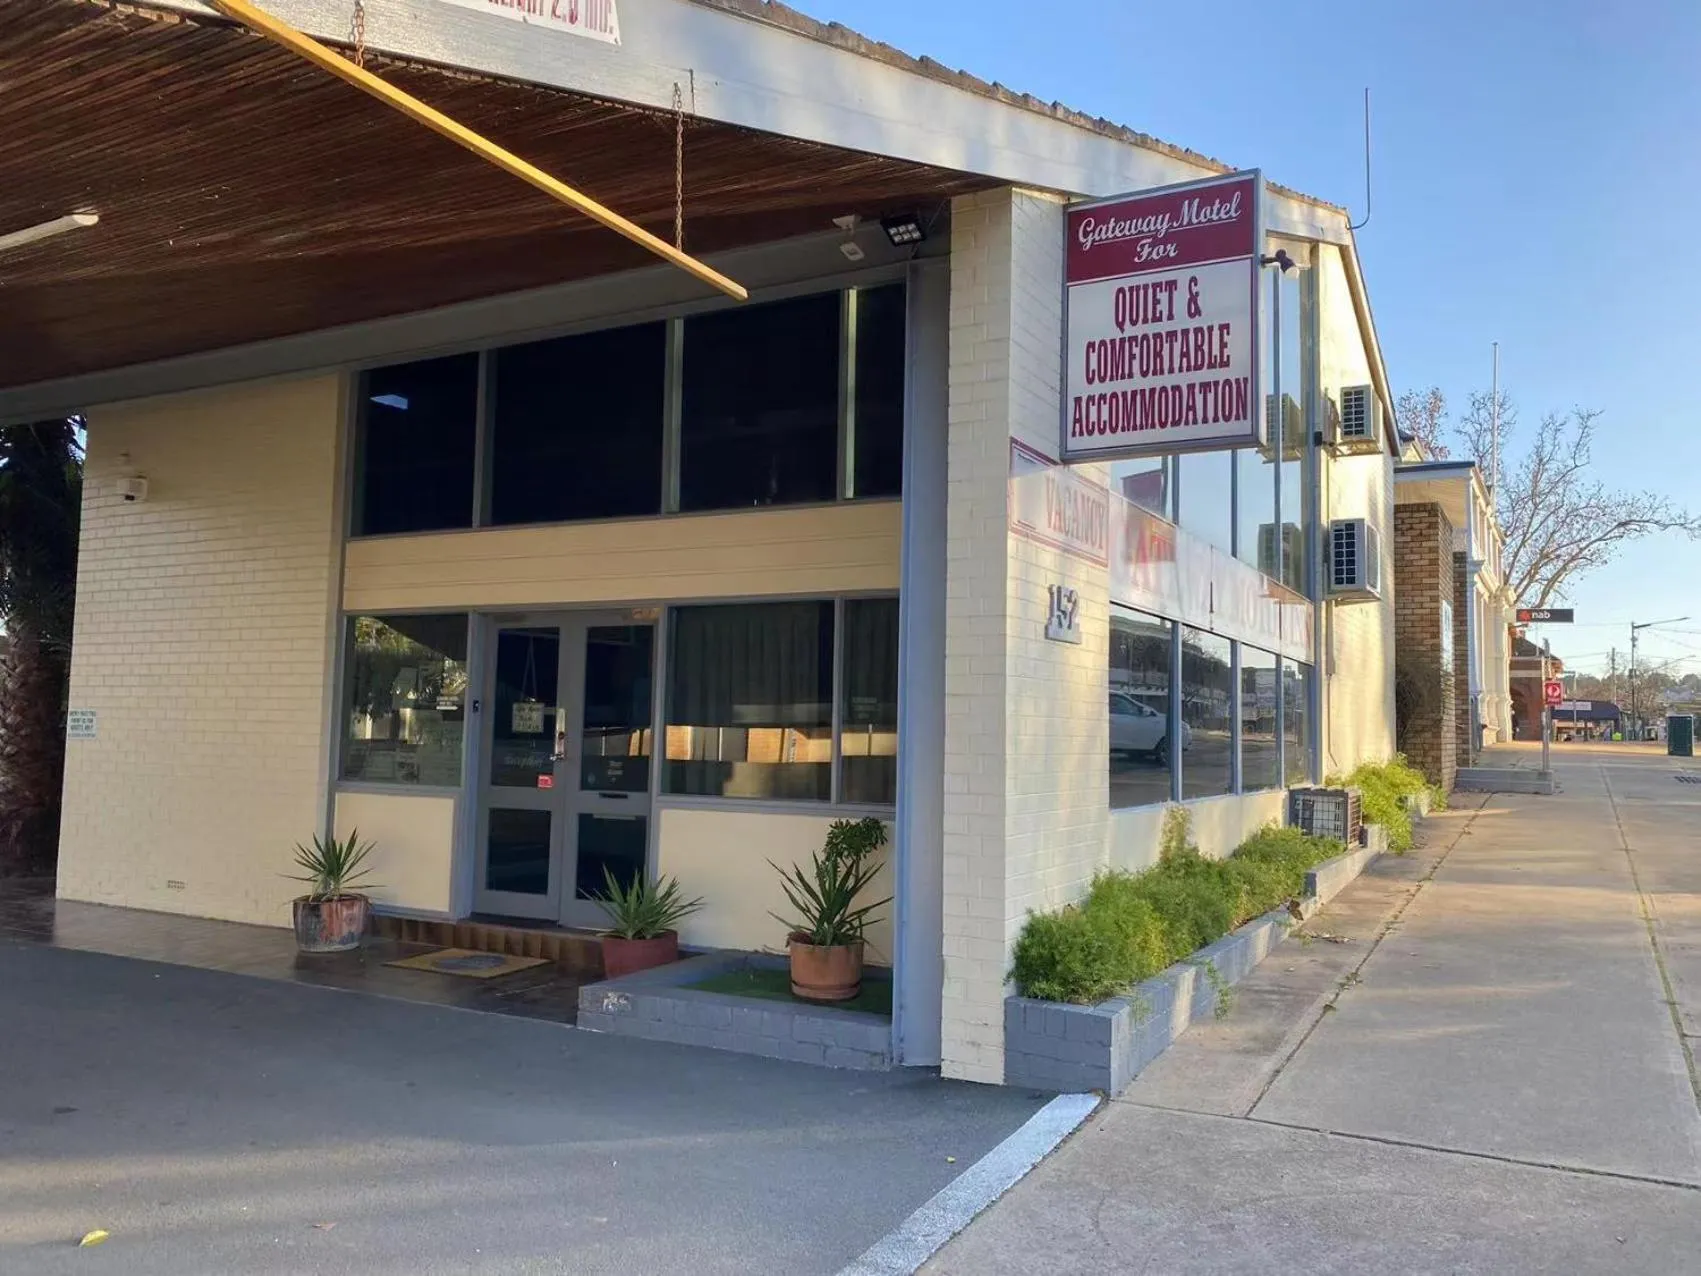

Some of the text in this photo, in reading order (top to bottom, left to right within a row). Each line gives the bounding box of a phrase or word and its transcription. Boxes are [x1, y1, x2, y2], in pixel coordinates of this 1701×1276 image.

[1079, 191, 1241, 250] Gateway Motel
[1134, 238, 1178, 262] For
[1115, 275, 1201, 333] QUIET &
[1085, 323, 1230, 385] COMFORTABLE
[1072, 377, 1248, 437] ACCOMMODATION
[1532, 610, 1551, 619] nab
